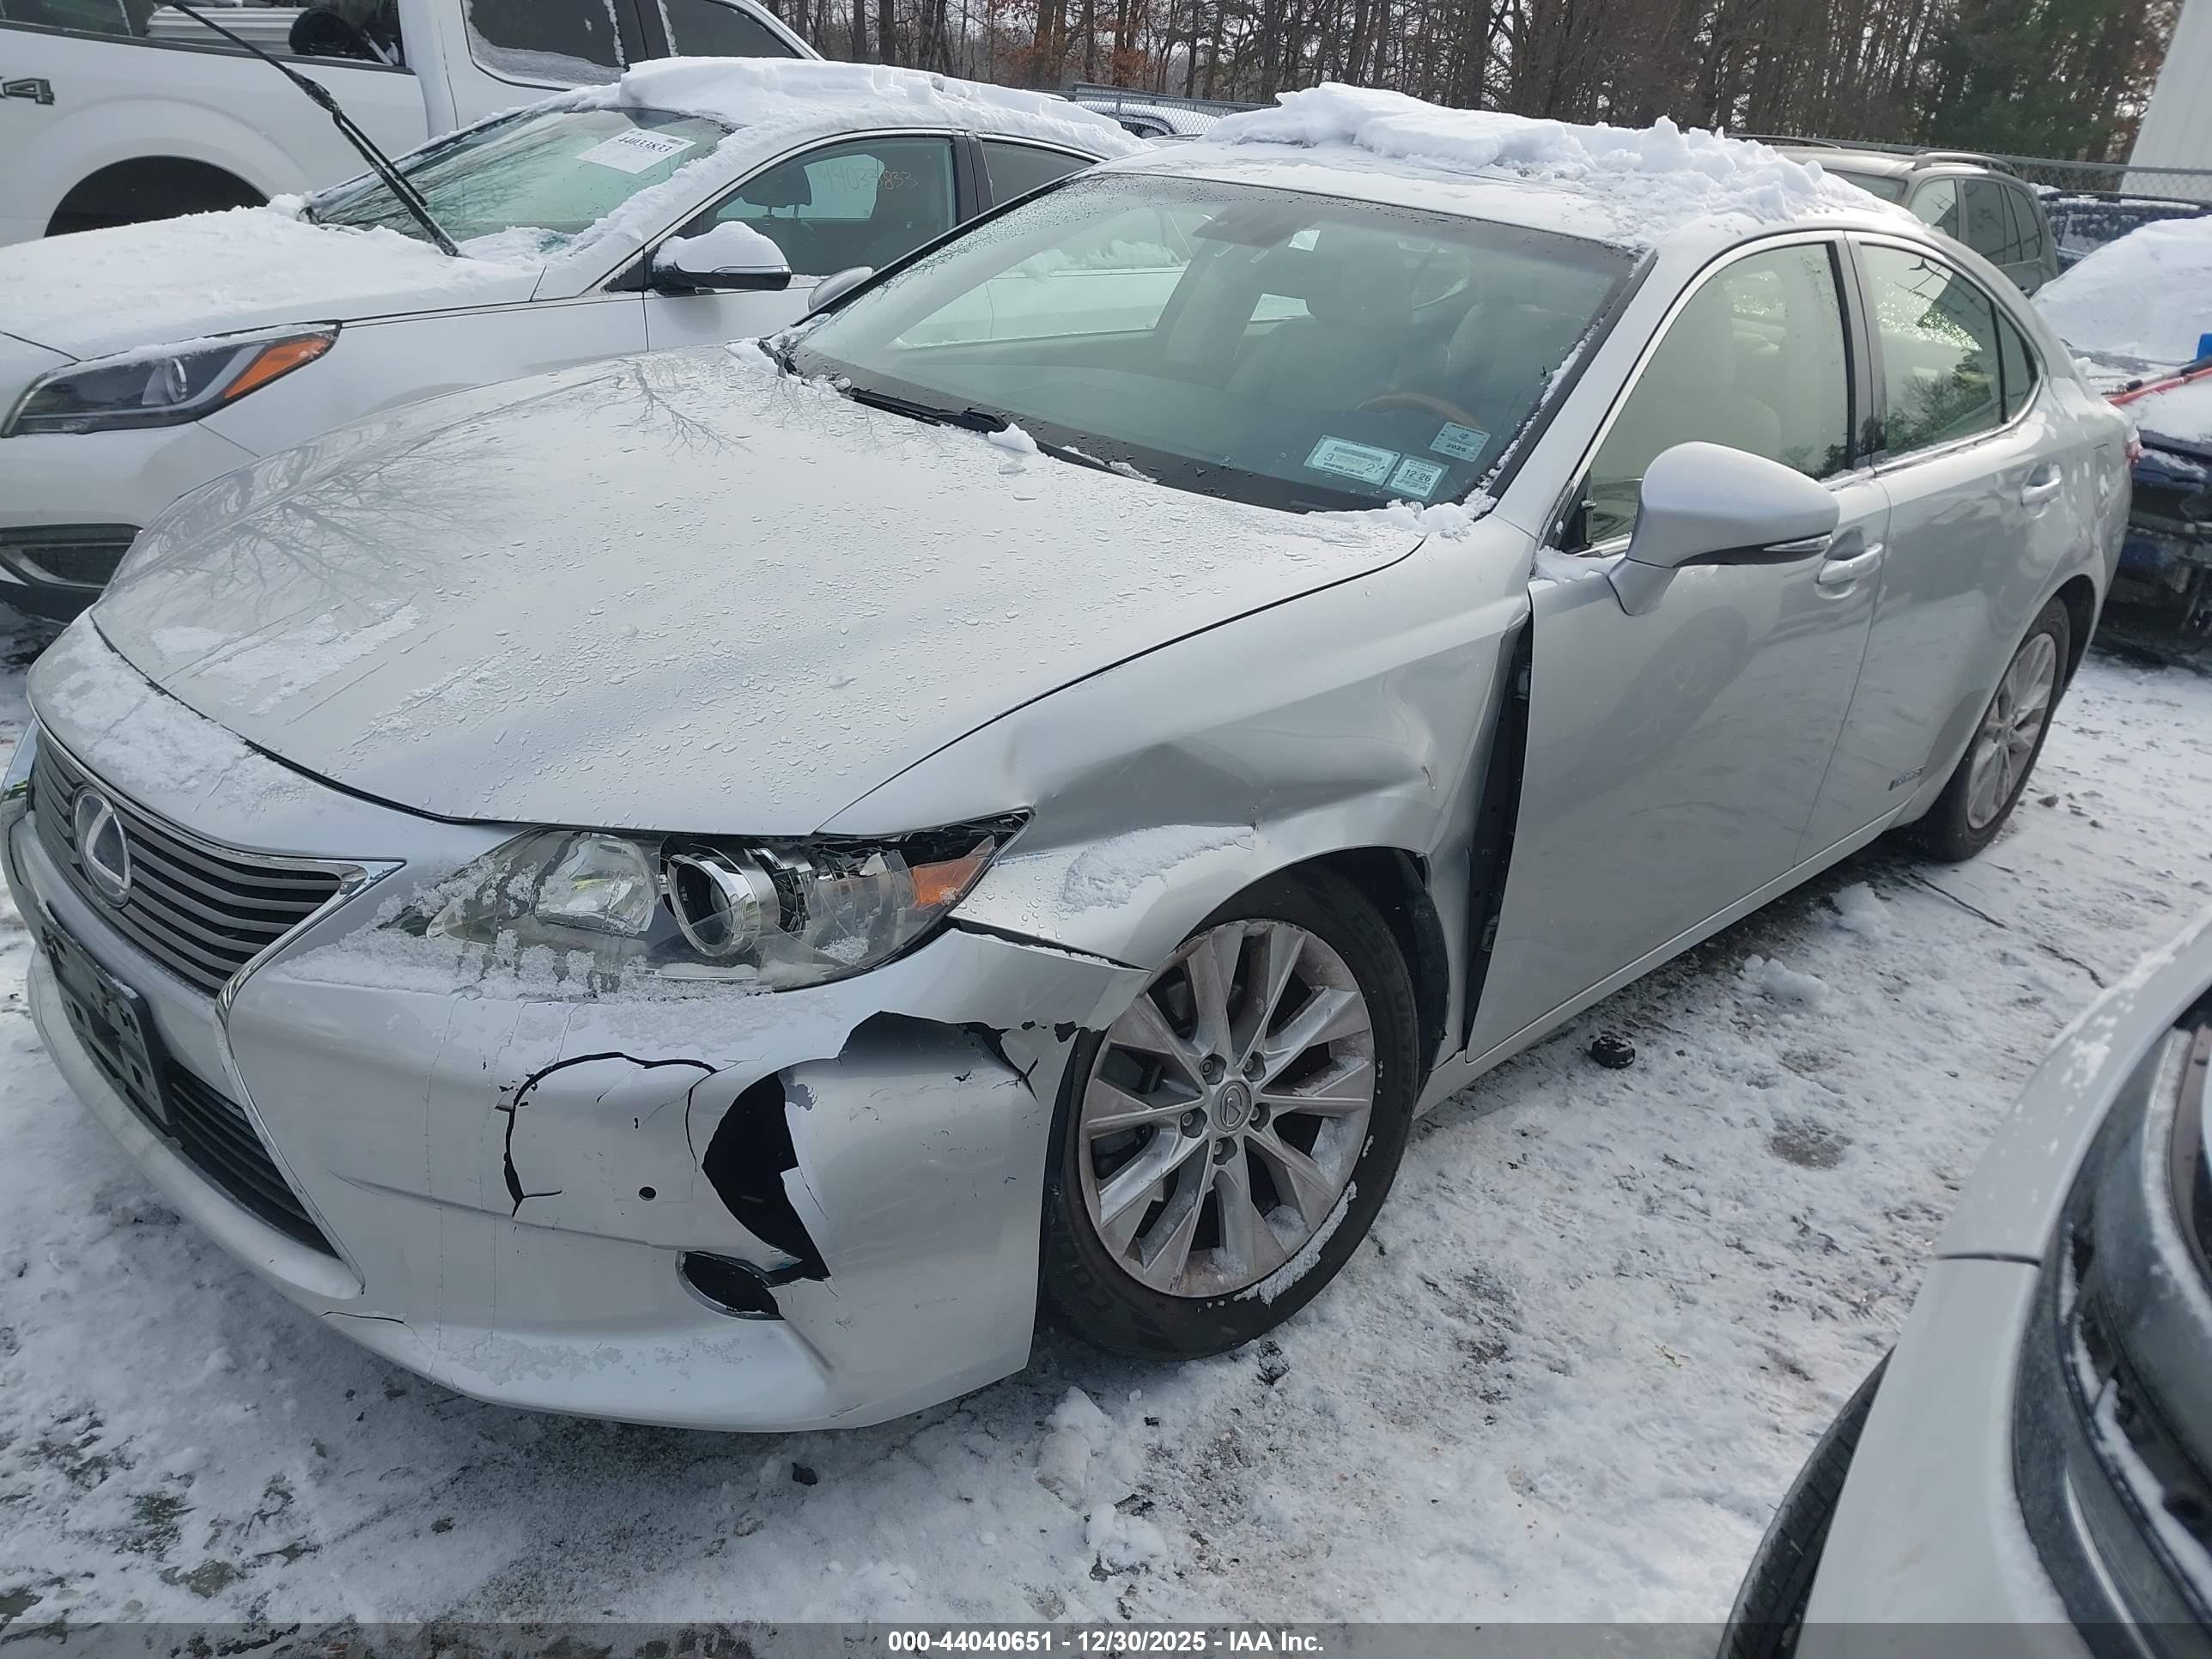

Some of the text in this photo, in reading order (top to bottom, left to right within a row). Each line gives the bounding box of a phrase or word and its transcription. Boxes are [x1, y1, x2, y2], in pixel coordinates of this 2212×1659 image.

[0, 76, 55, 106] 4
[1405, 468, 1417, 478] 12
[1418, 472, 1432, 483] 26
